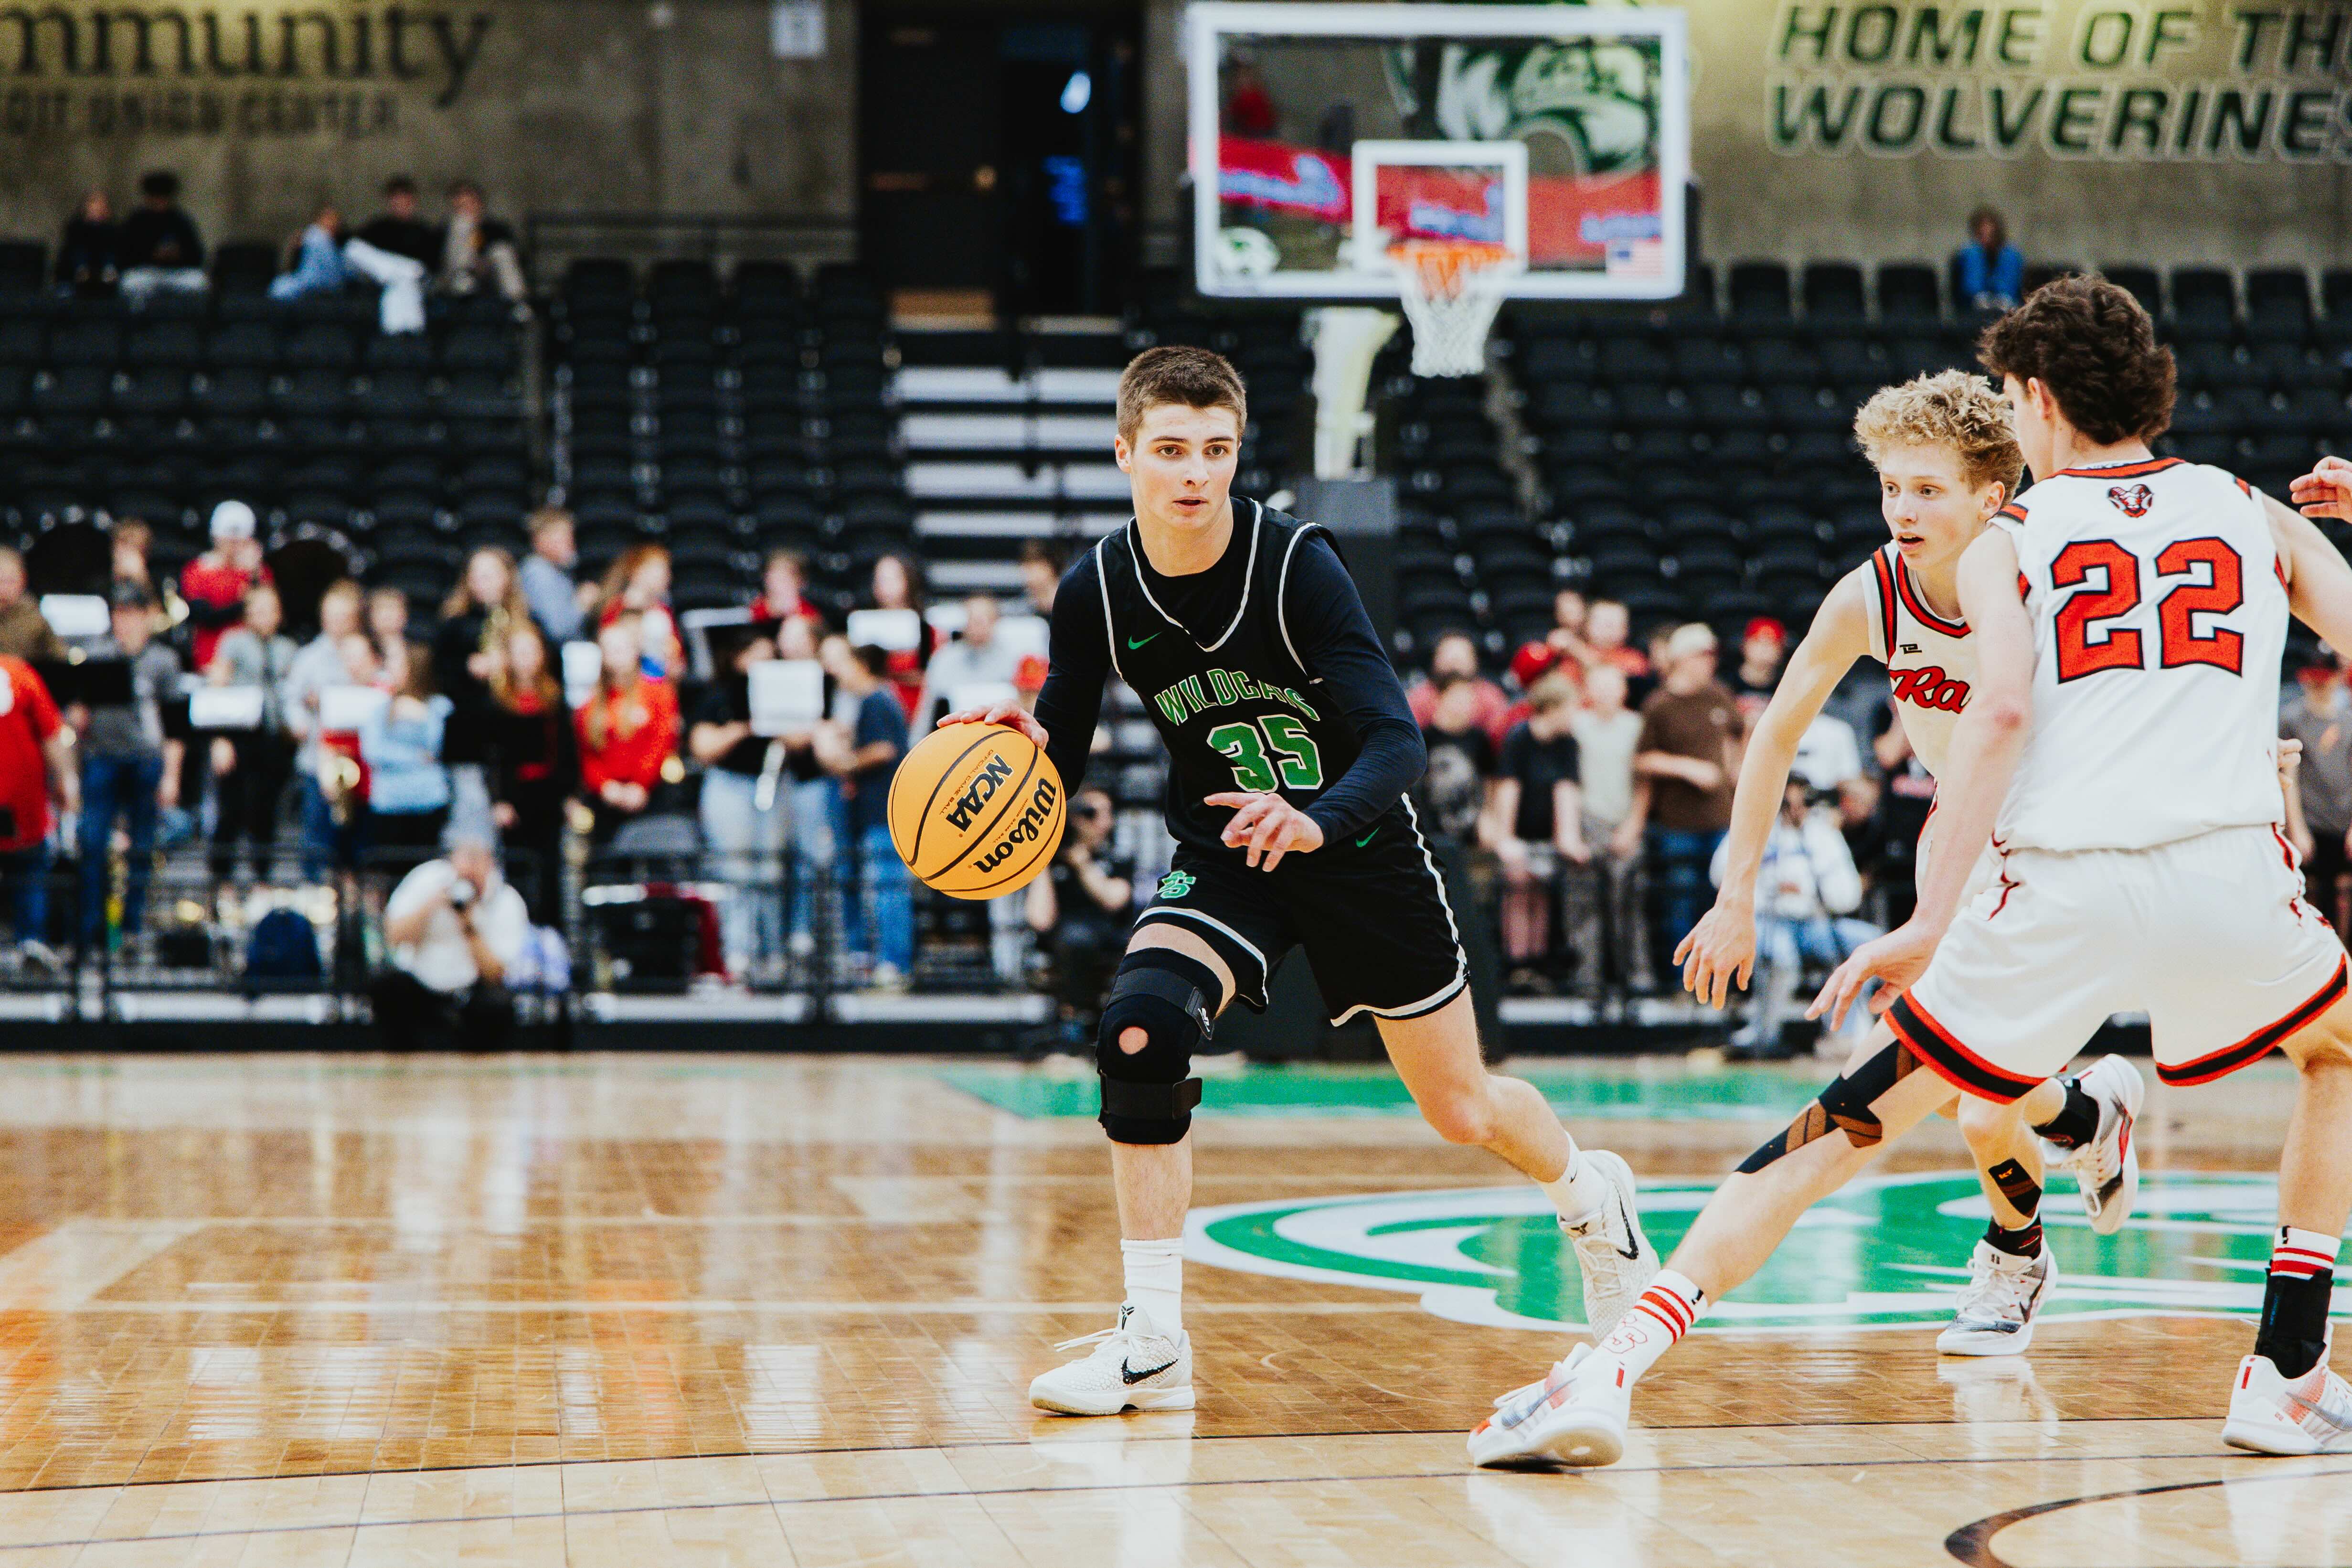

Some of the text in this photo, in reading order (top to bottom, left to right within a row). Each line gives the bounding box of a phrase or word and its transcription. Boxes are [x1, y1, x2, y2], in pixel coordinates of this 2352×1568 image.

[1780, 4, 2352, 72] HOME OF TH
[2050, 536, 2244, 685] 22
[939, 748, 994, 815] OFFICIAL GAME BALL
[945, 753, 1014, 832] NCAA
[1206, 714, 1324, 793] 35
[972, 778, 1057, 874] Wilson
